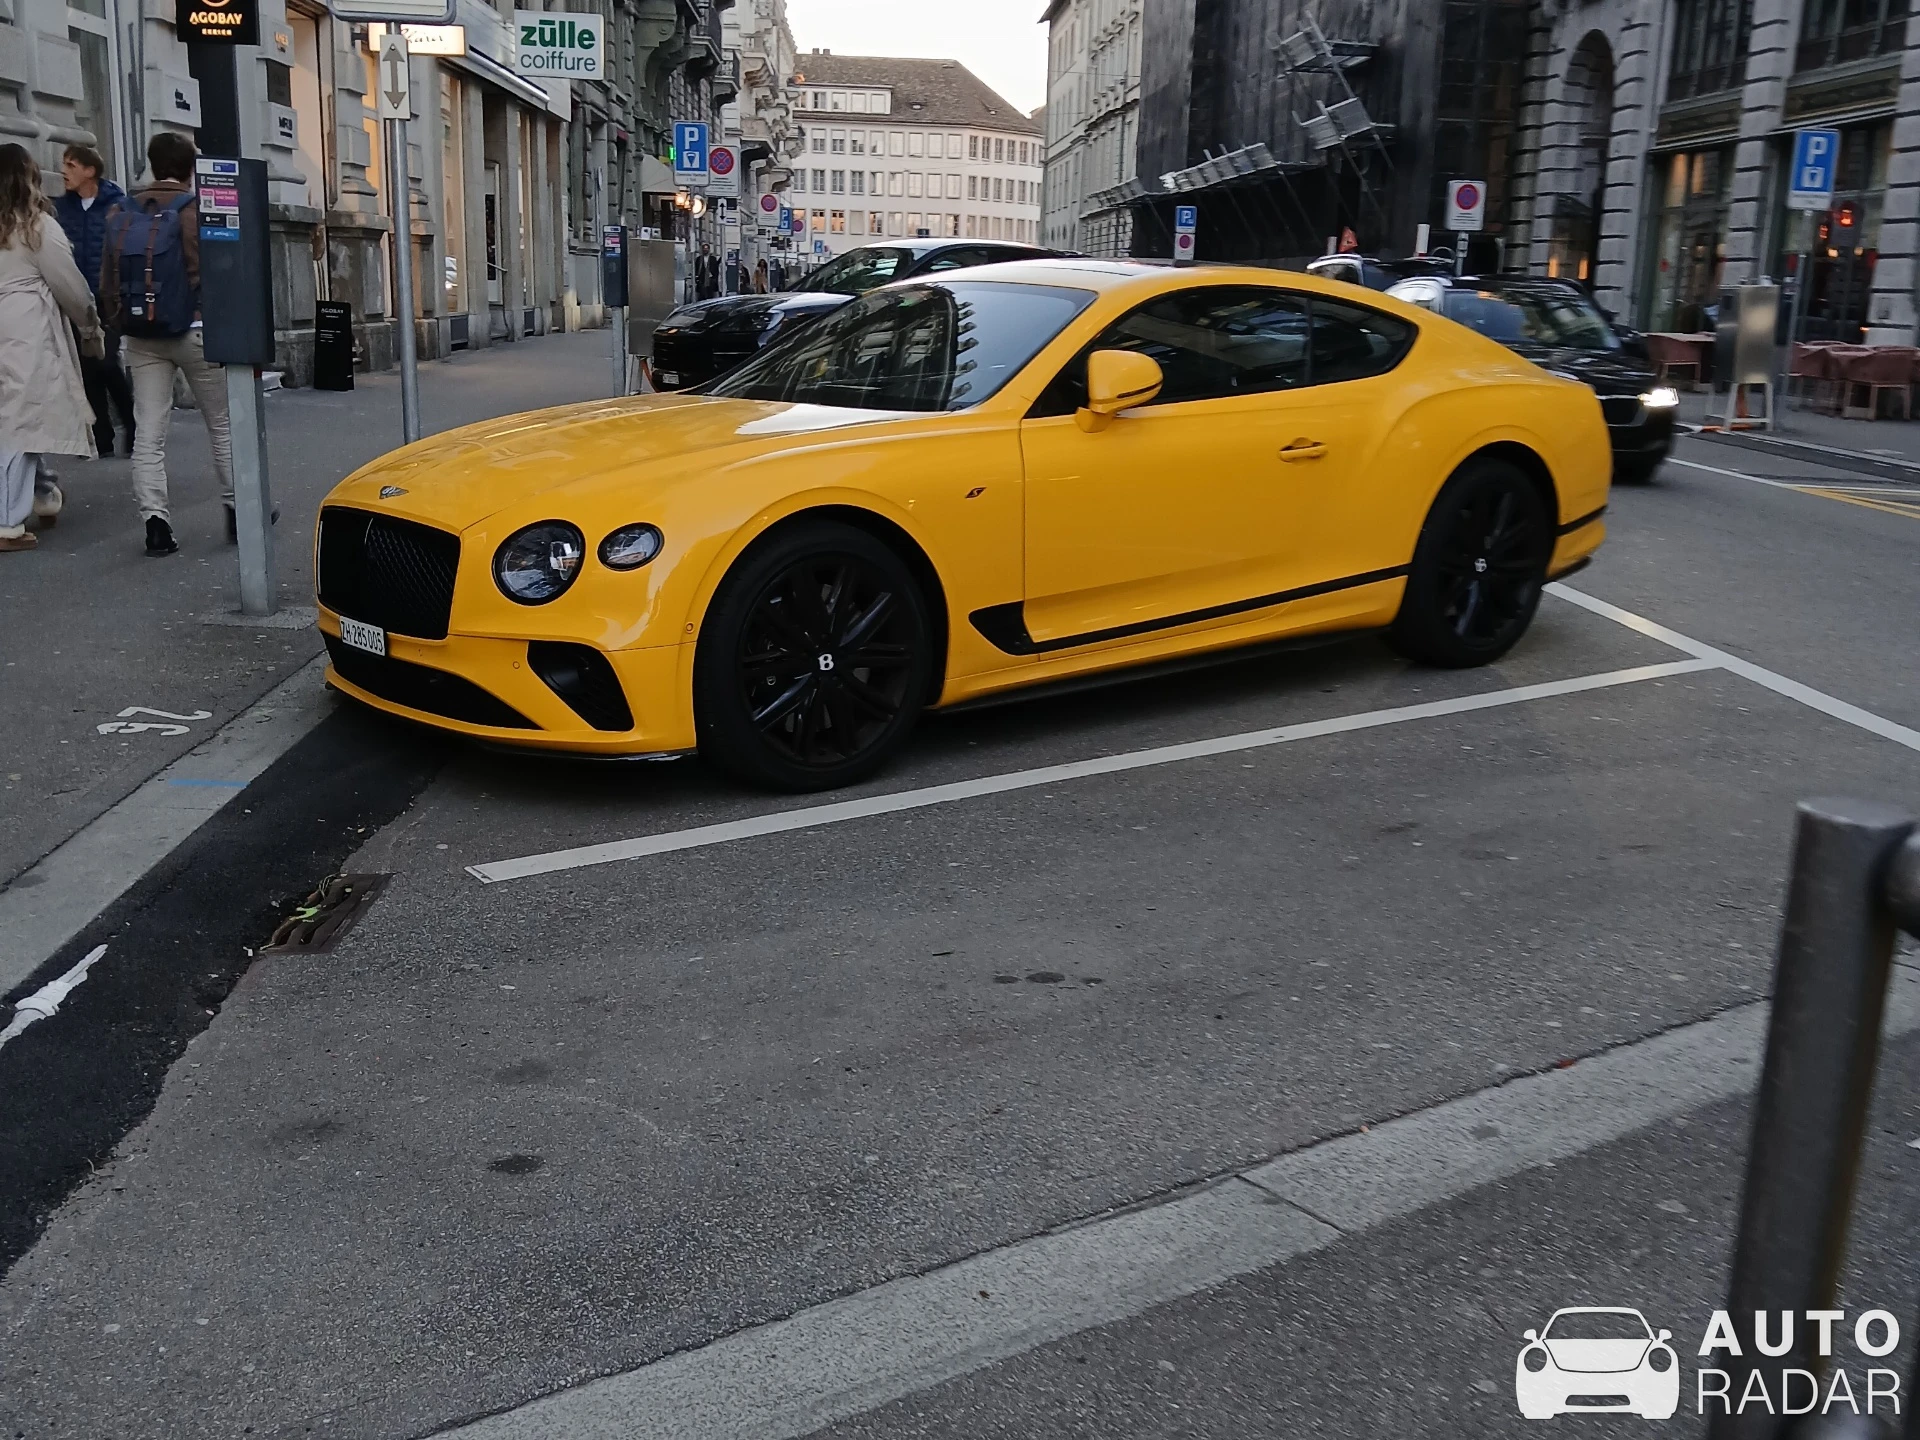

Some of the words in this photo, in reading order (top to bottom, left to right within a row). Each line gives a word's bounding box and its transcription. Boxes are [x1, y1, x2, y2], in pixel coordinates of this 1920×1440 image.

[189, 11, 243, 25] AGOBAY
[520, 51, 596, 72] coiffure
[684, 127, 699, 150] P
[1806, 136, 1828, 165] P
[818, 653, 834, 671] B
